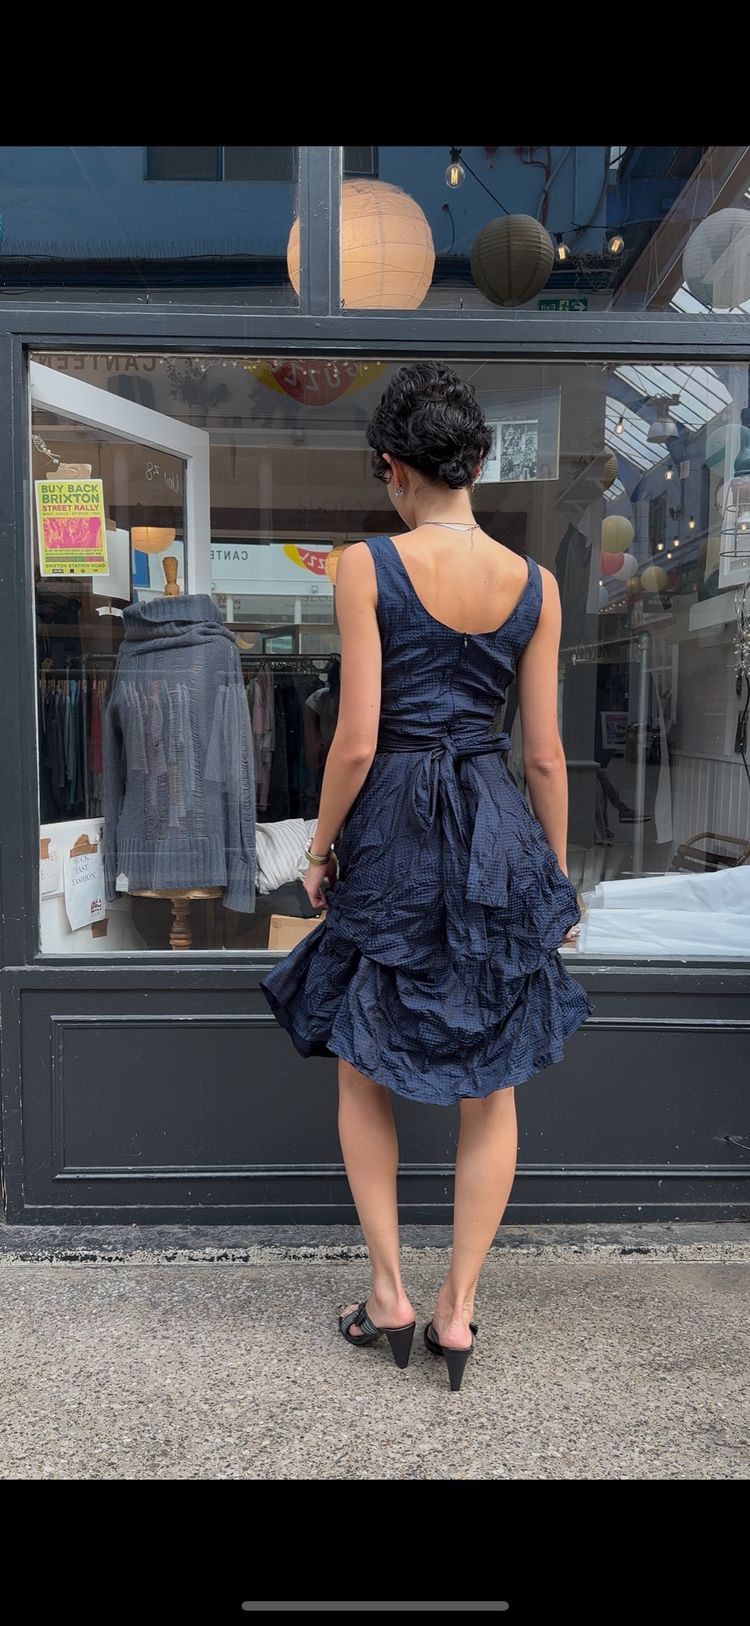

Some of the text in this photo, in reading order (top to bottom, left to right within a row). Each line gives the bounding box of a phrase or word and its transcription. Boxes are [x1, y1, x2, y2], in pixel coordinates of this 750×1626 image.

[41, 484, 98, 493] BUY BACK
[41, 493, 100, 504] BRIXTON
[41, 504, 72, 512] STREET
[75, 864, 88, 874] FAST
[72, 872, 96, 886] FASHION
